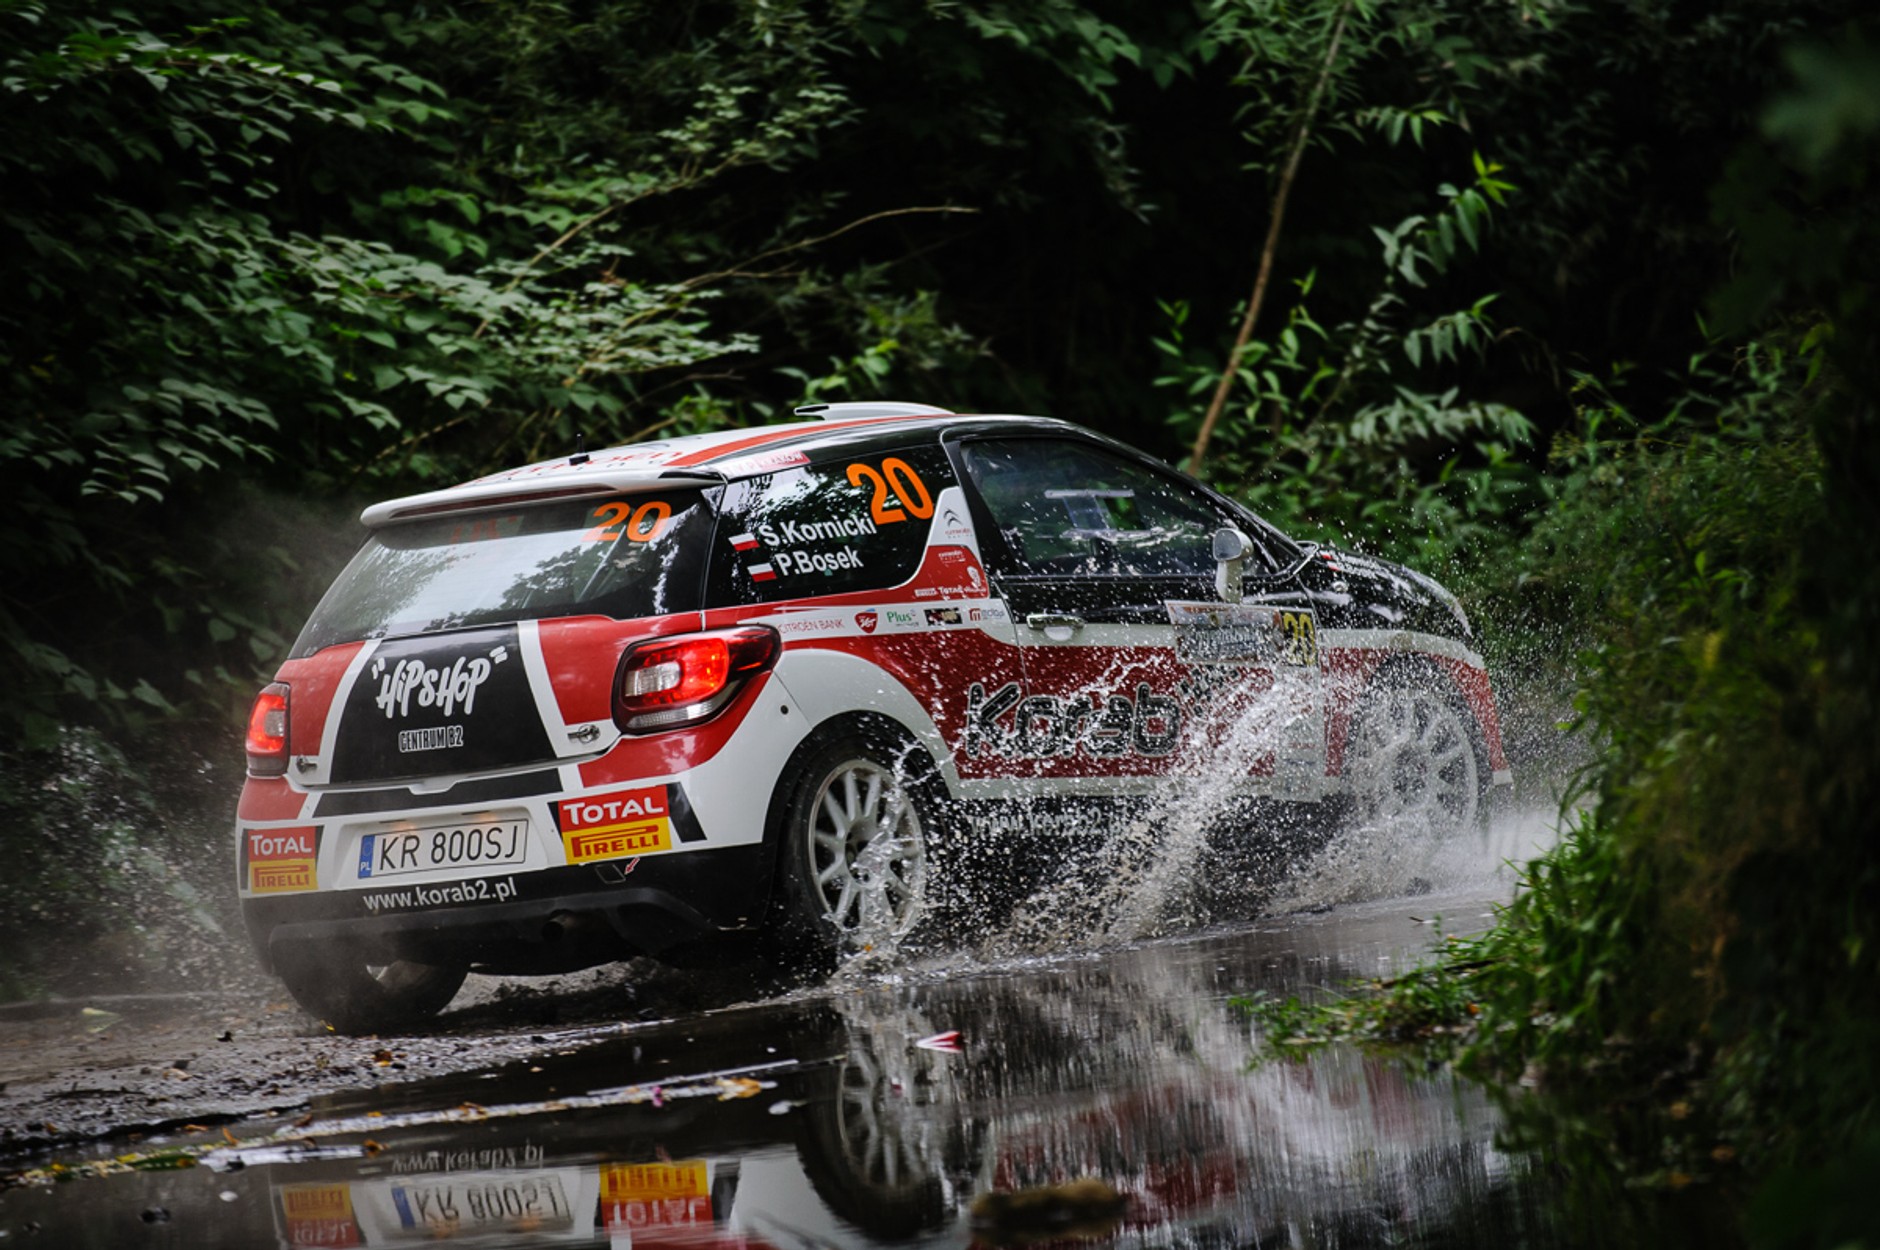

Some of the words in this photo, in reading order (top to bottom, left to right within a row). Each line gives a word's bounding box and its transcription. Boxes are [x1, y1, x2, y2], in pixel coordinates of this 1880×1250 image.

[846, 457, 934, 525] 20
[582, 501, 671, 542] 20
[758, 512, 877, 547] S.Kornicki
[774, 545, 864, 576] P.Bosek
[964, 681, 1182, 760] Korab
[398, 727, 446, 753] CENTRUM
[563, 797, 664, 825] TOTAL
[250, 834, 312, 856] TOTAL
[378, 834, 421, 872] KR
[430, 825, 518, 863] 800SJ
[571, 825, 660, 857] PIRELLI
[254, 865, 310, 888] PIRELLI
[360, 861, 372, 871] PL
[362, 876, 518, 911] www.korab2.pl
